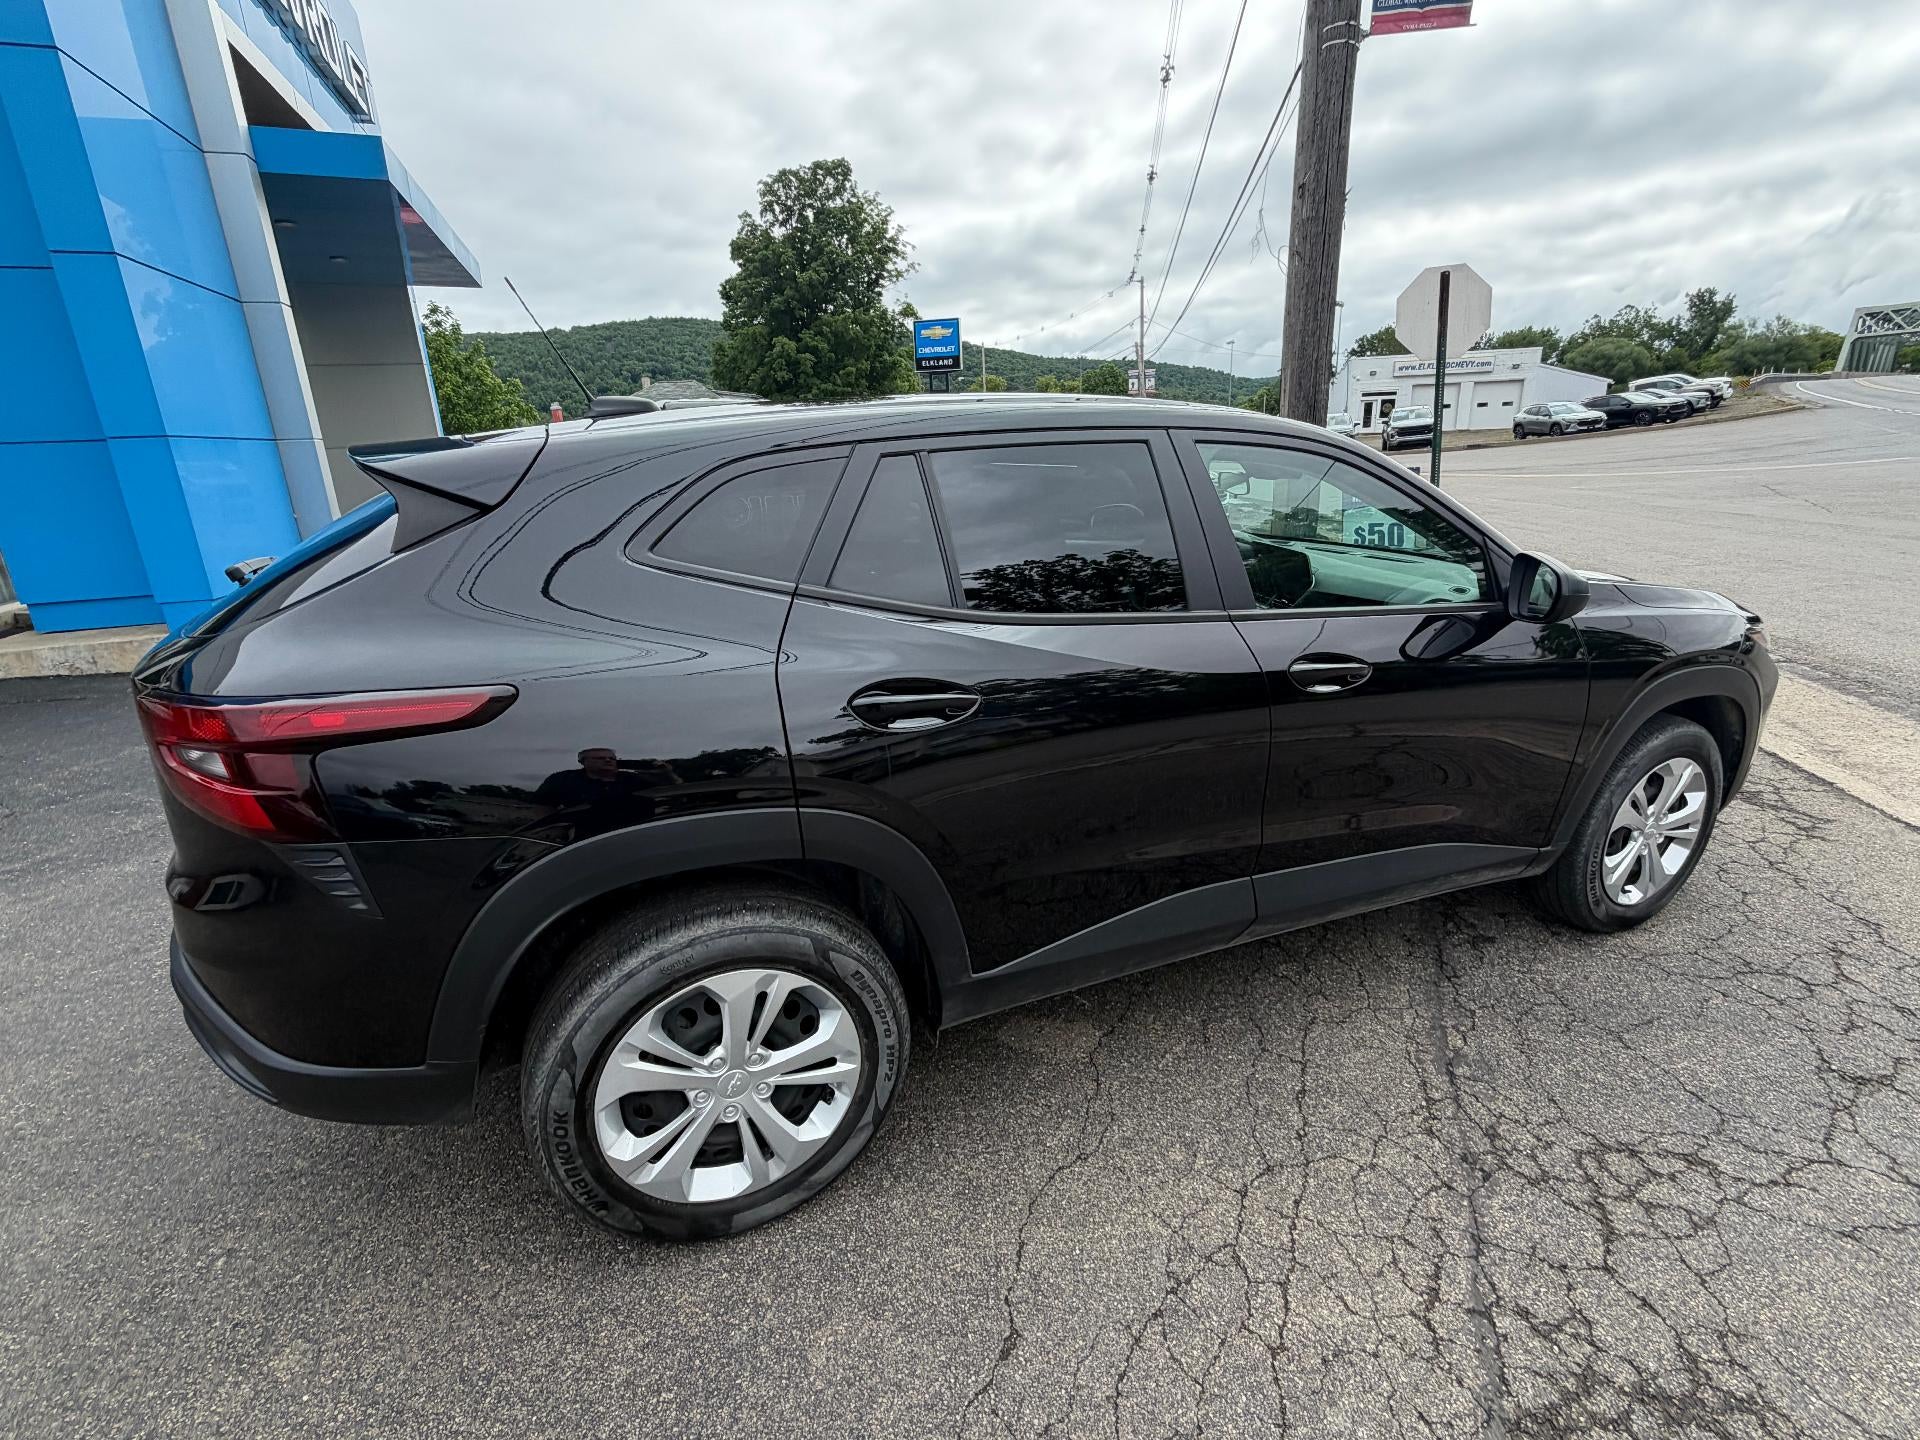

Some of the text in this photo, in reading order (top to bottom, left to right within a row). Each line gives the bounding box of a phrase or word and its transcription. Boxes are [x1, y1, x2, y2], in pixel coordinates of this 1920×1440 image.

[918, 345, 955, 354] CHEVROLET
[922, 359, 953, 367] ELKLAND
[1398, 360, 1492, 372] www.ELKLDCHEVY.com
[1353, 522, 1405, 548] $50
[850, 969, 895, 1083] Dynapro HP2
